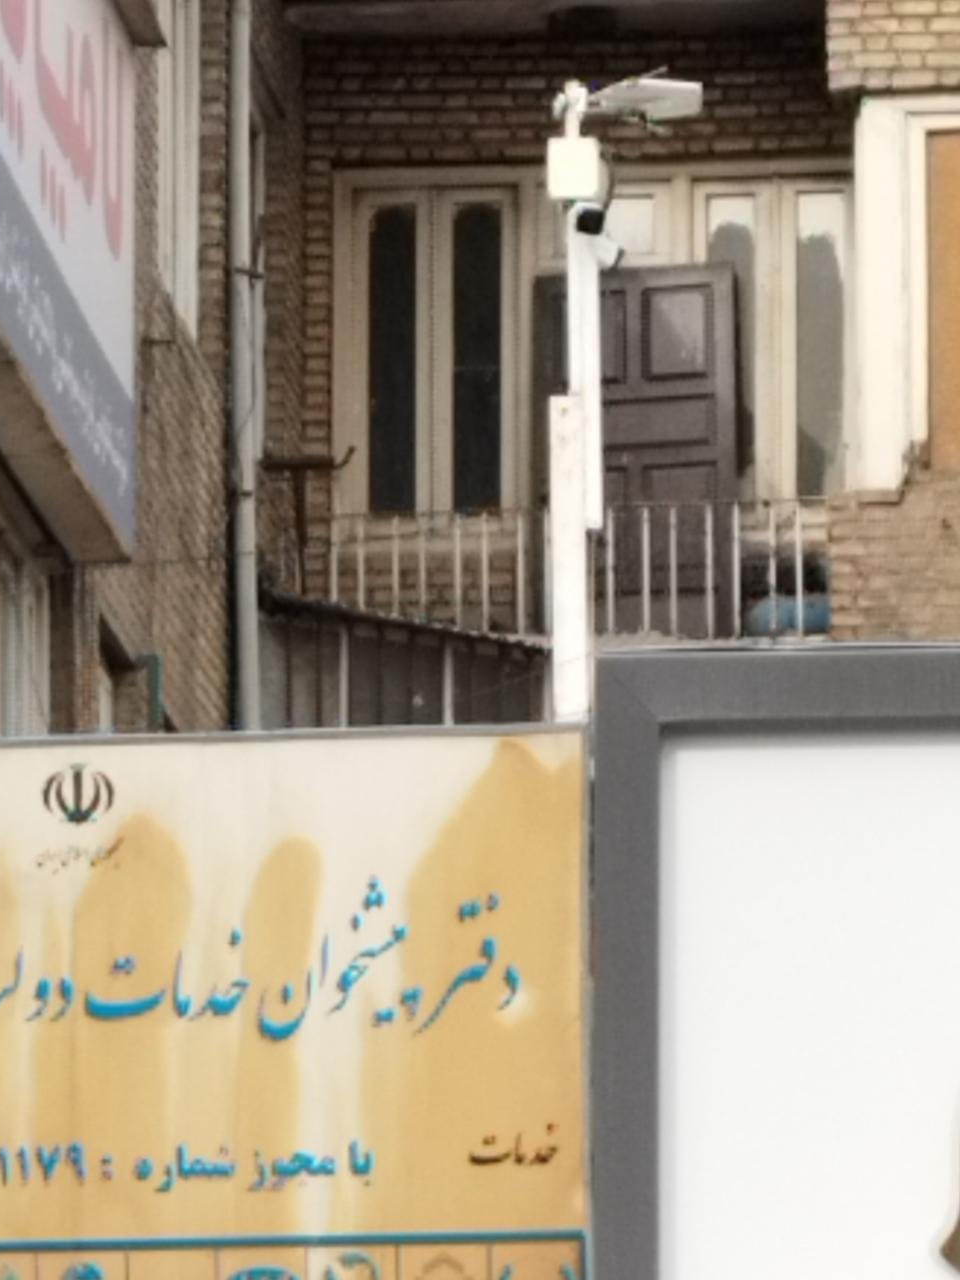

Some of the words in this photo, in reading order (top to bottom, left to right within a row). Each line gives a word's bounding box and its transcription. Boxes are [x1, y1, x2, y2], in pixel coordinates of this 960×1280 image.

[84, 926, 251, 1021] خدمات
[258, 874, 424, 1041] پیشخوان
[411, 892, 520, 1036] دفتر
[248, 1147, 337, 1191] مجوز
[348, 1140, 375, 1187] با
[467, 1123, 560, 1168] خدمات
